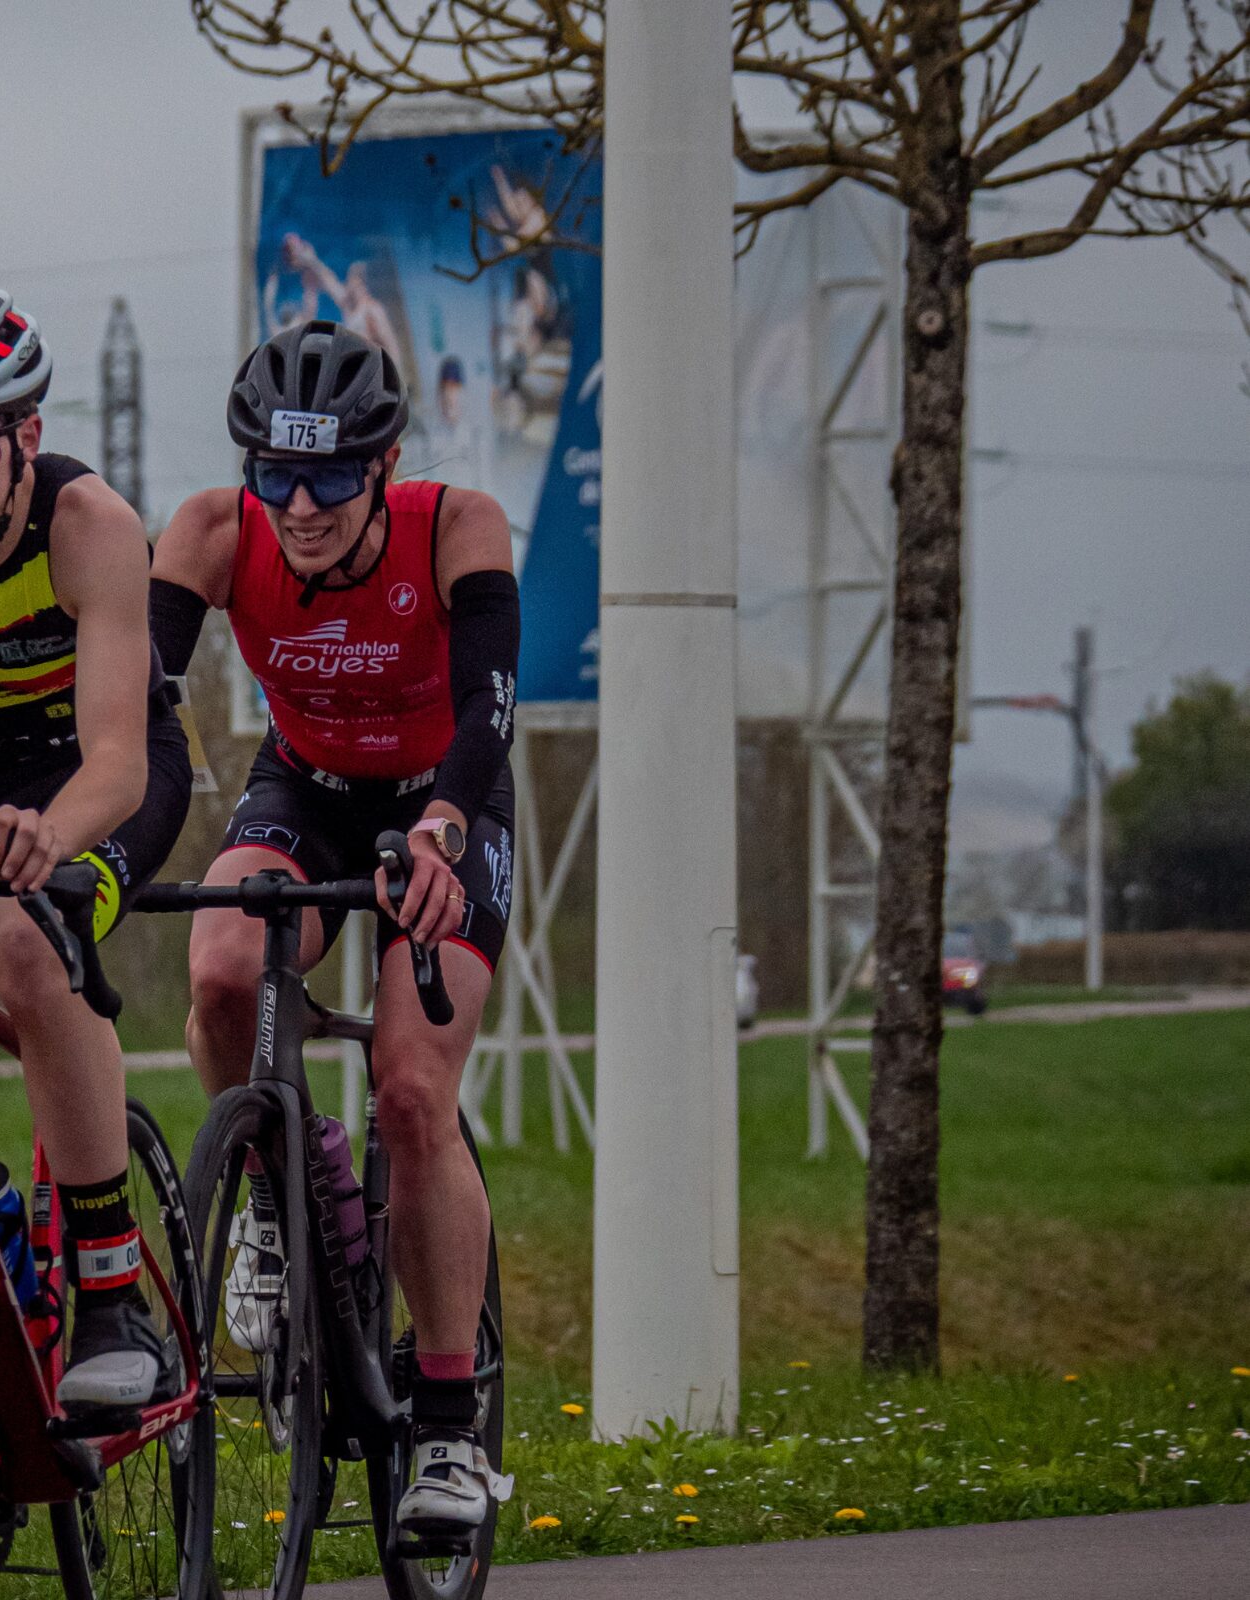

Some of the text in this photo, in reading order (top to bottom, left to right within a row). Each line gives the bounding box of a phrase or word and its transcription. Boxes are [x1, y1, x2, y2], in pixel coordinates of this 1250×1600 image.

[281, 413, 317, 424] Running
[287, 423, 318, 449] 175
[267, 637, 385, 679] Troyes
[323, 640, 399, 655] triathlon
[260, 983, 277, 1067] GIANT
[70, 1190, 120, 1210] Troyes
[139, 1406, 181, 1440] BH
